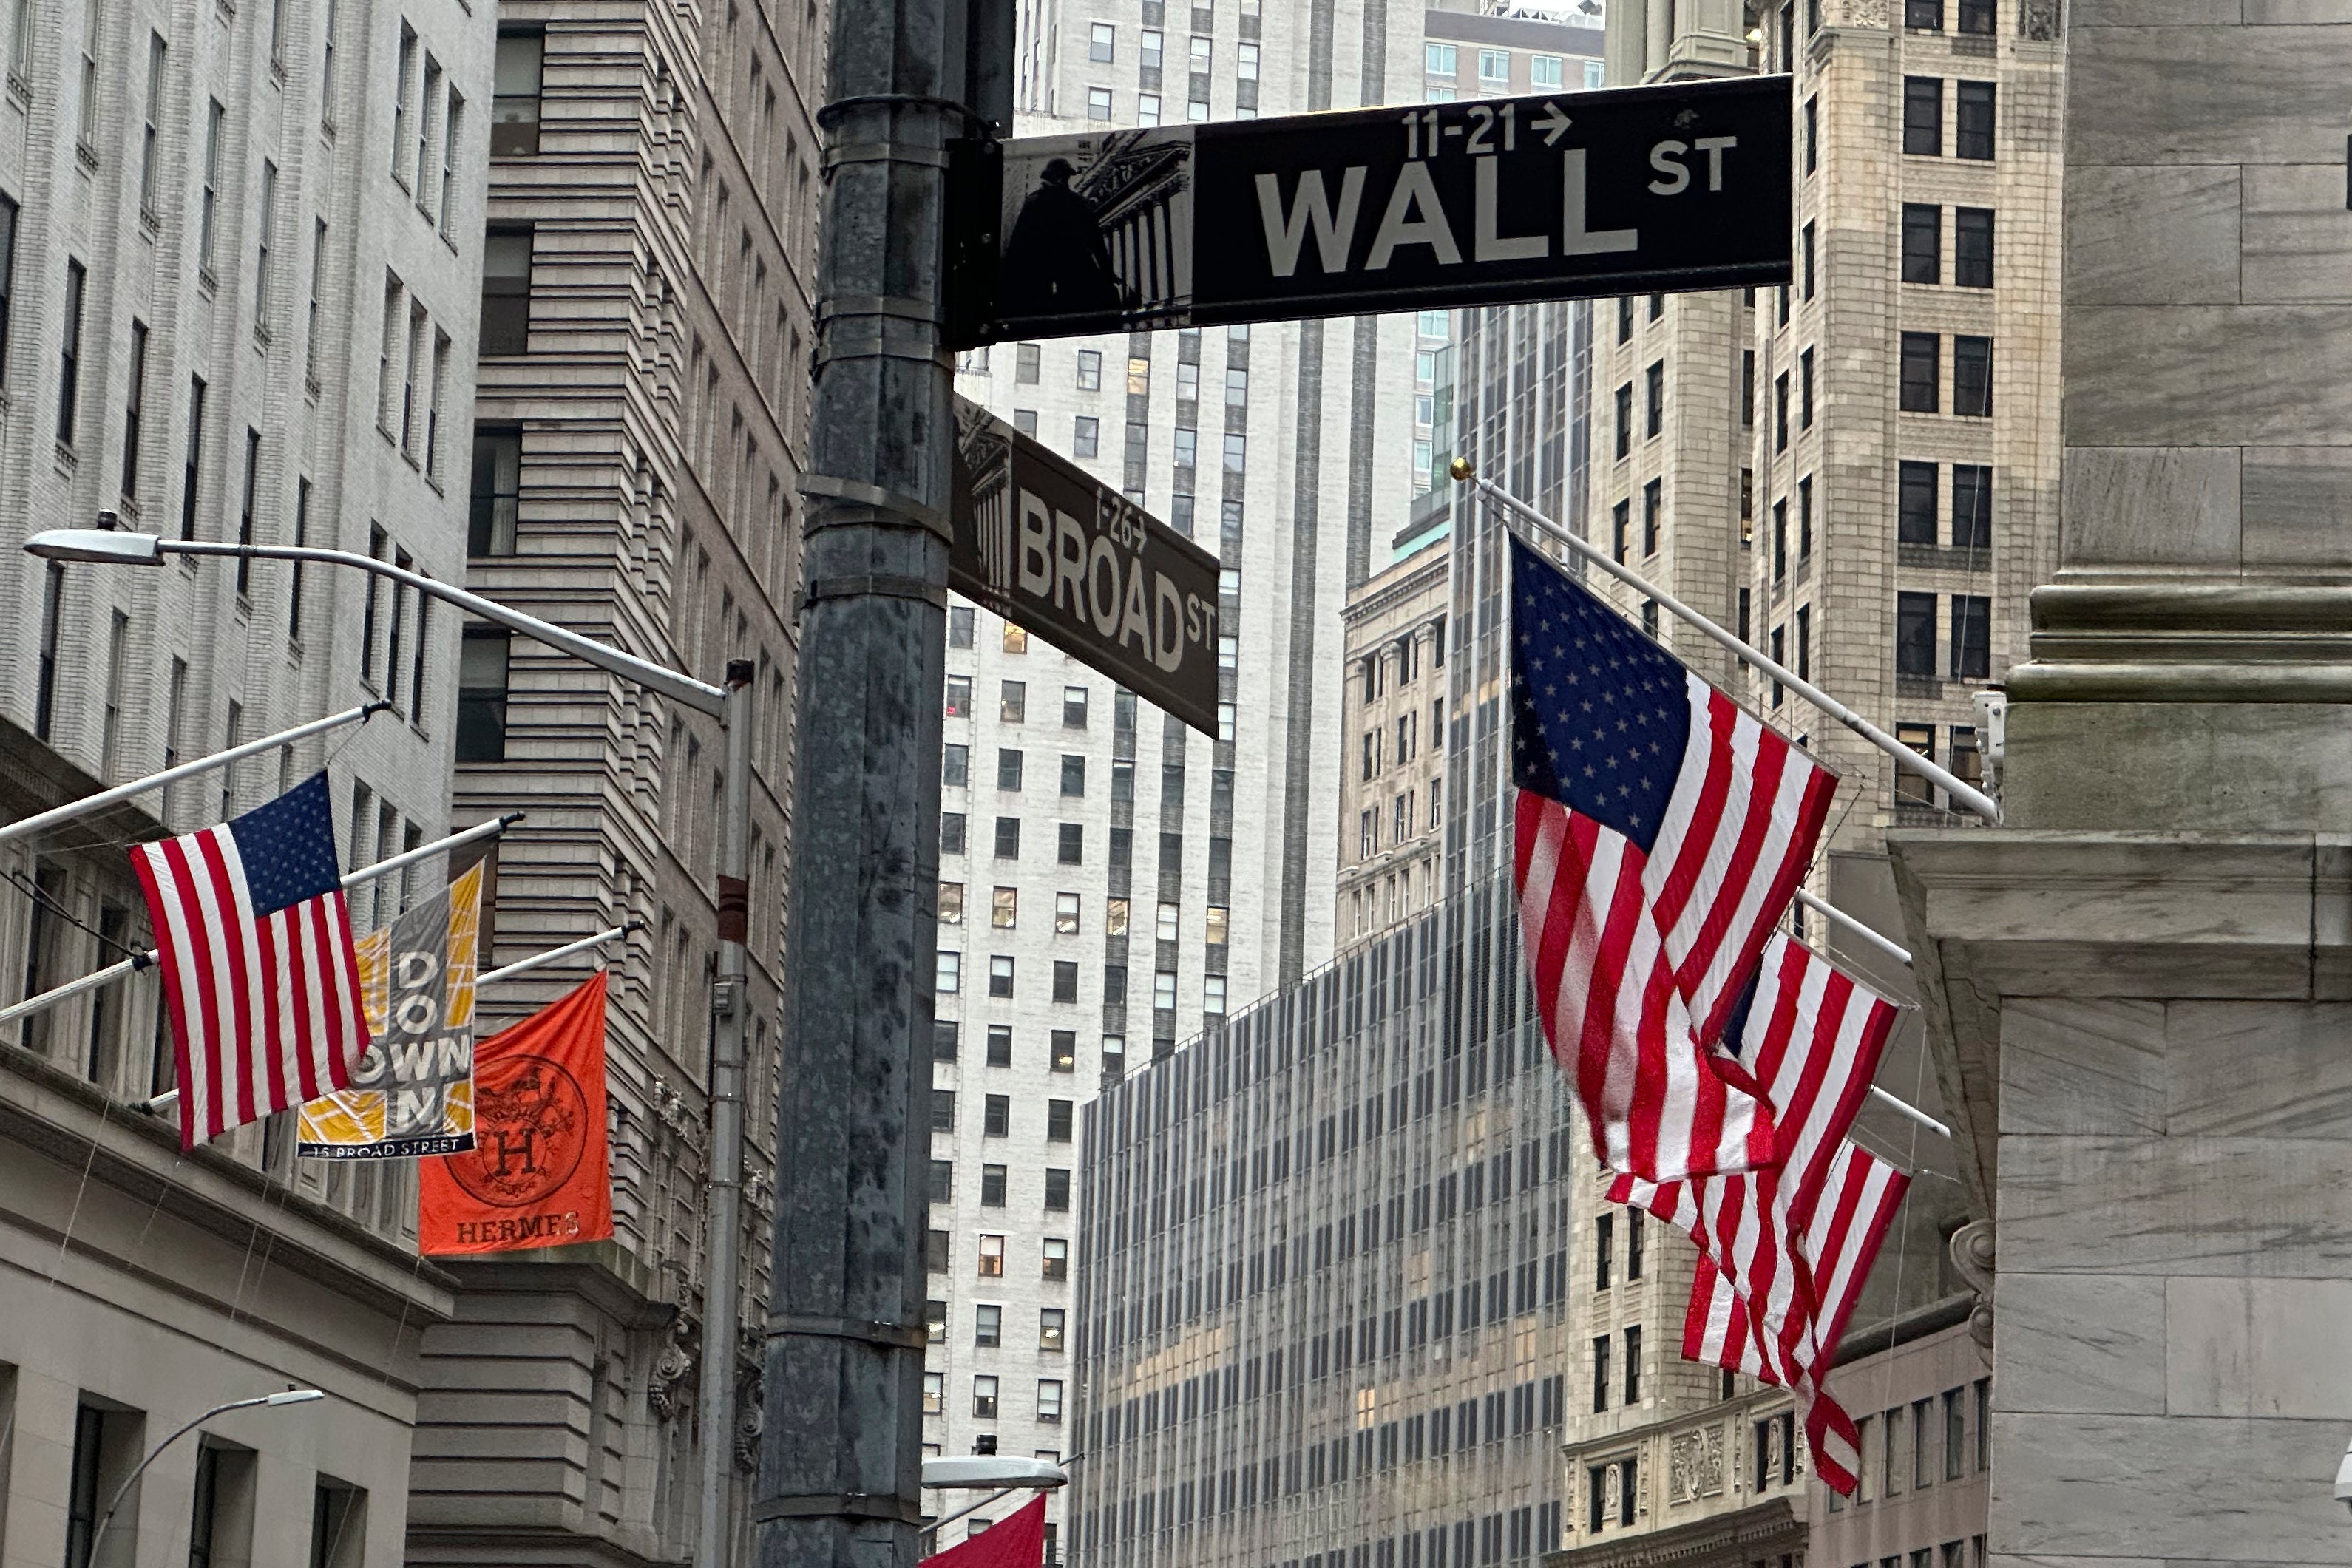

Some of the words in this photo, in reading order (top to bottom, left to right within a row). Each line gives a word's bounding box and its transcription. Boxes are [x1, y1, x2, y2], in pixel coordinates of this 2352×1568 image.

[1402, 103, 1516, 158] 11-21
[1254, 148, 1638, 276] WALL
[1648, 136, 1738, 195] ST
[1096, 486, 1132, 549] 1-26
[1019, 486, 1184, 673] BROAD
[1186, 593, 1216, 650] ST
[336, 1144, 395, 1158] BROAD
[401, 1138, 459, 1155] STREET
[493, 1127, 538, 1178] H
[456, 1210, 580, 1244] HERMES
